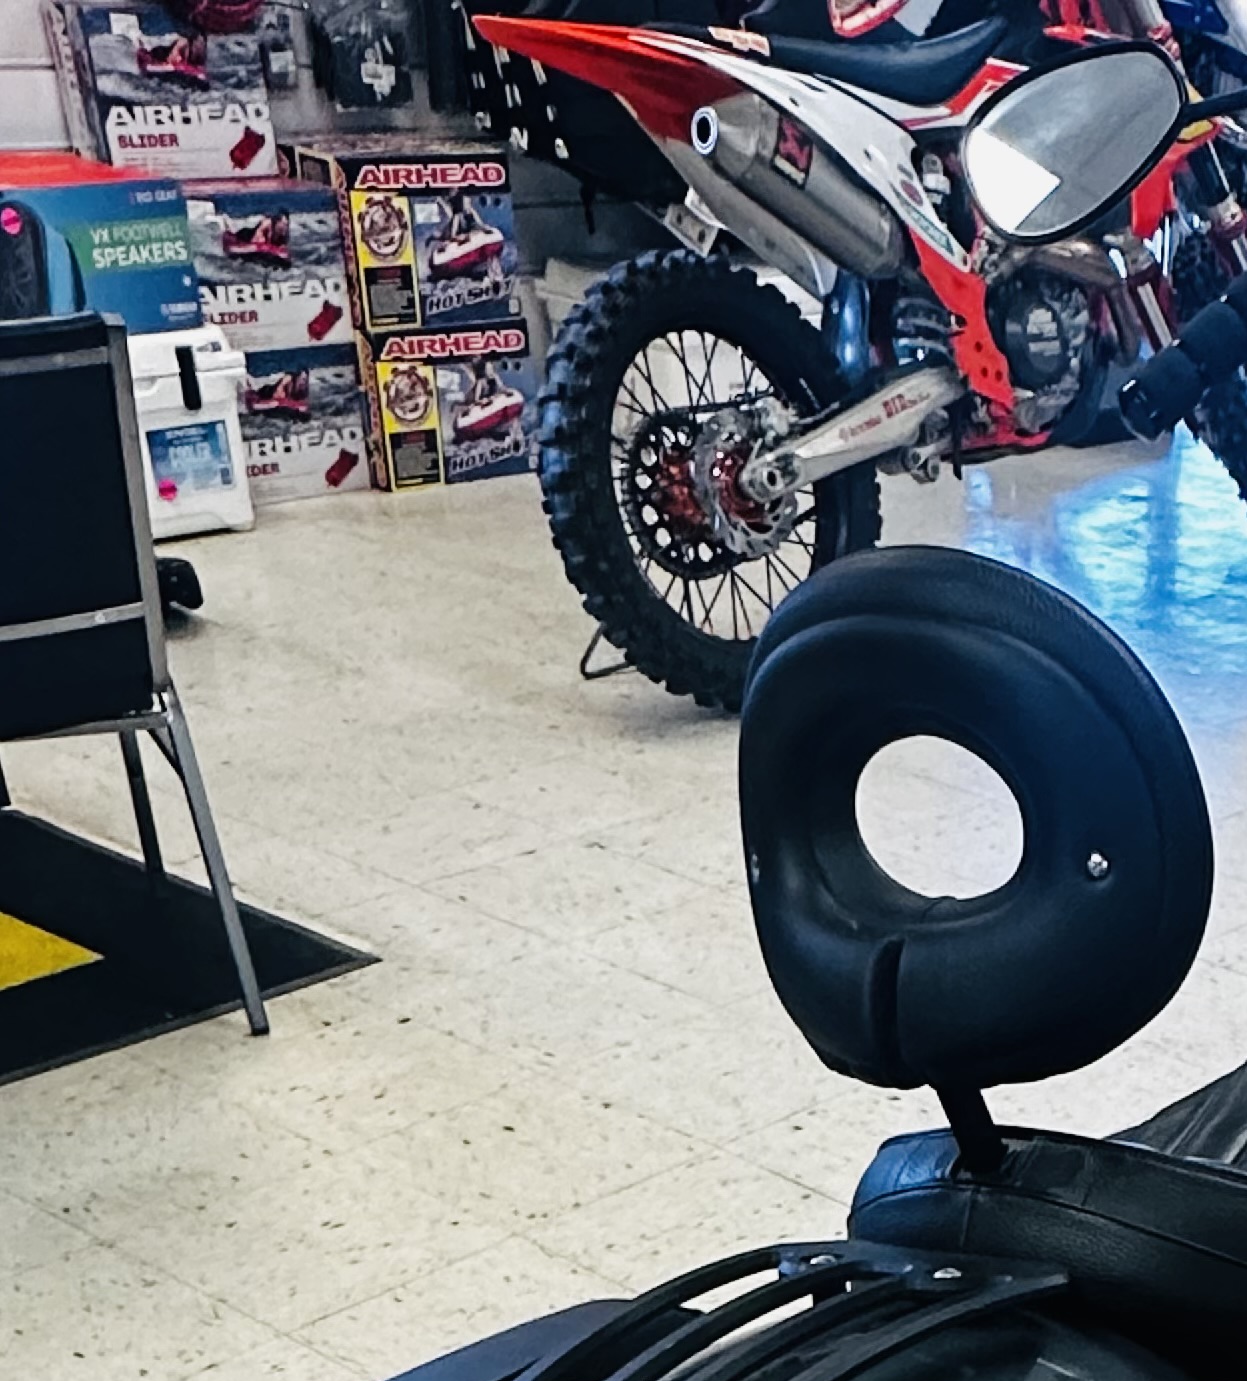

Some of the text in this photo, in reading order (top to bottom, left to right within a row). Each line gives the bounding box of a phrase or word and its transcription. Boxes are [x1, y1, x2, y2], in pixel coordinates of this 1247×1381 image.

[108, 103, 270, 127] AIRHEAD
[117, 133, 180, 149] SLIDER
[355, 163, 506, 189] AIRHEAD
[92, 239, 188, 269] SPEAKERS
[380, 329, 525, 360] AIRHEAD
